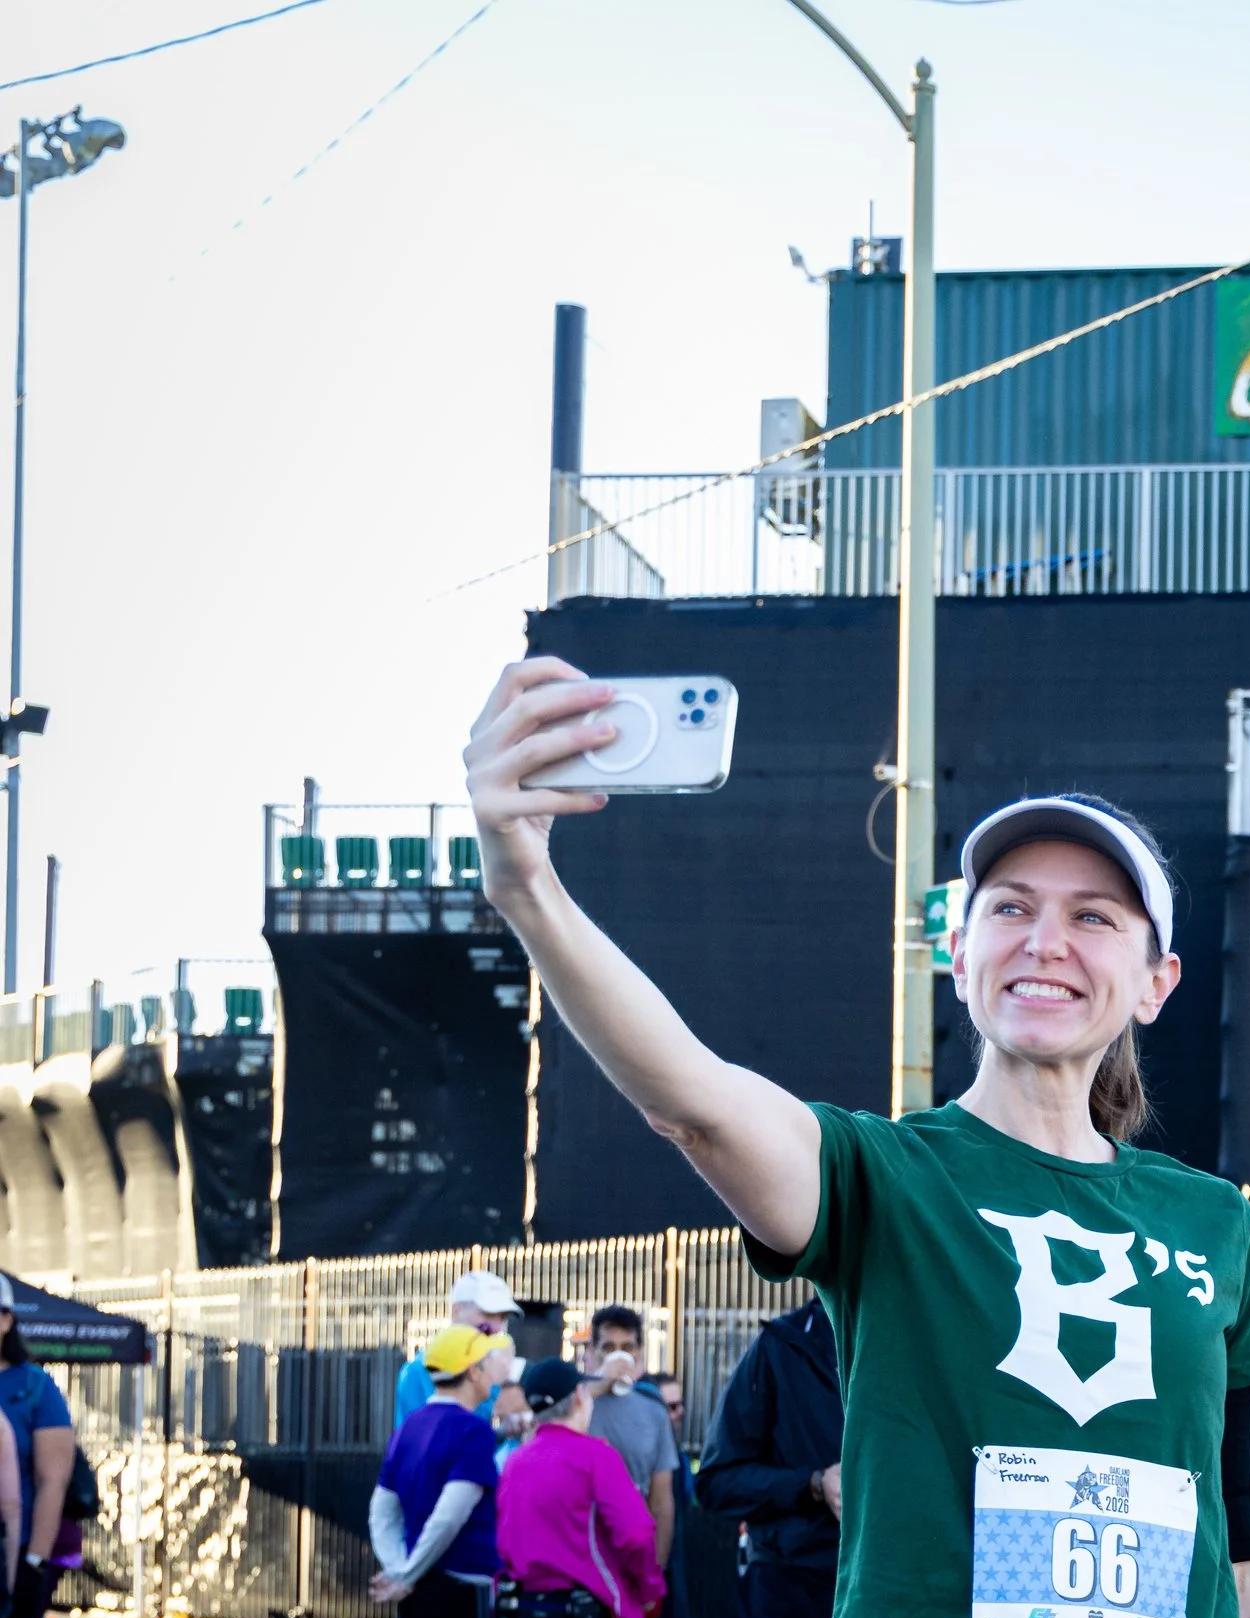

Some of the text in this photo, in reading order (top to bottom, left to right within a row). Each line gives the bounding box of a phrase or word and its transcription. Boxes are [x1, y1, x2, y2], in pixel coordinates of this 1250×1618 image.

[76, 1323, 131, 1339] EVENT
[999, 1453, 1036, 1464] Robin
[999, 1470, 1049, 1482] Freeman
[1100, 1473, 1129, 1486] FREEDOM
[1116, 1486, 1129, 1498] RUN
[1106, 1496, 1129, 1513] 2026
[1051, 1517, 1140, 1608] 66
